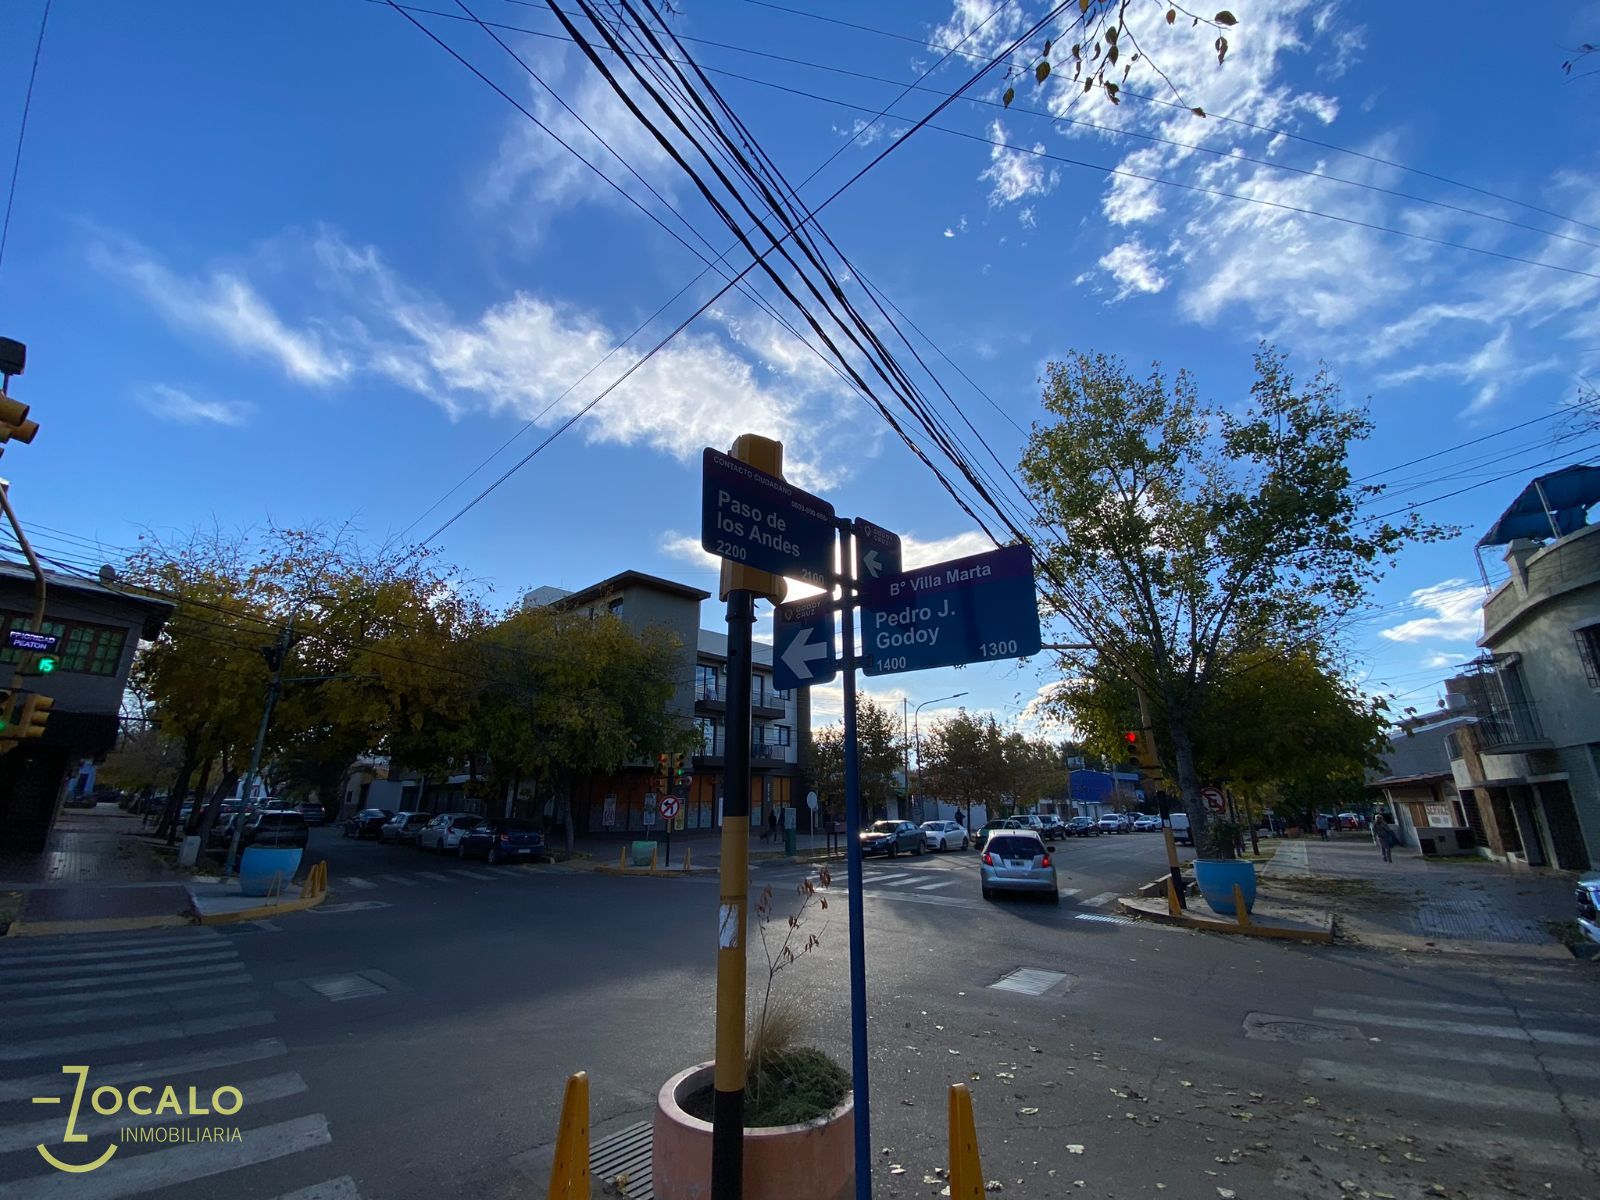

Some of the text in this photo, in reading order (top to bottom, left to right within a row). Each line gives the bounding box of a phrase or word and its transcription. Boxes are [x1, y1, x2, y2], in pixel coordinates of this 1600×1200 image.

[714, 456, 792, 496] CONTACTO CIUDADANO
[718, 490, 787, 532] Paso de
[717, 511, 800, 557] los Andes
[716, 540, 747, 560] 2200
[801, 568, 825, 585] 2100
[910, 575, 942, 592] Villa
[946, 564, 992, 584] Marta
[875, 599, 956, 629] Pedro J.
[13, 639, 47, 650] PEATON
[876, 626, 940, 649] Godoy
[876, 639, 1018, 672] 1400 1300
